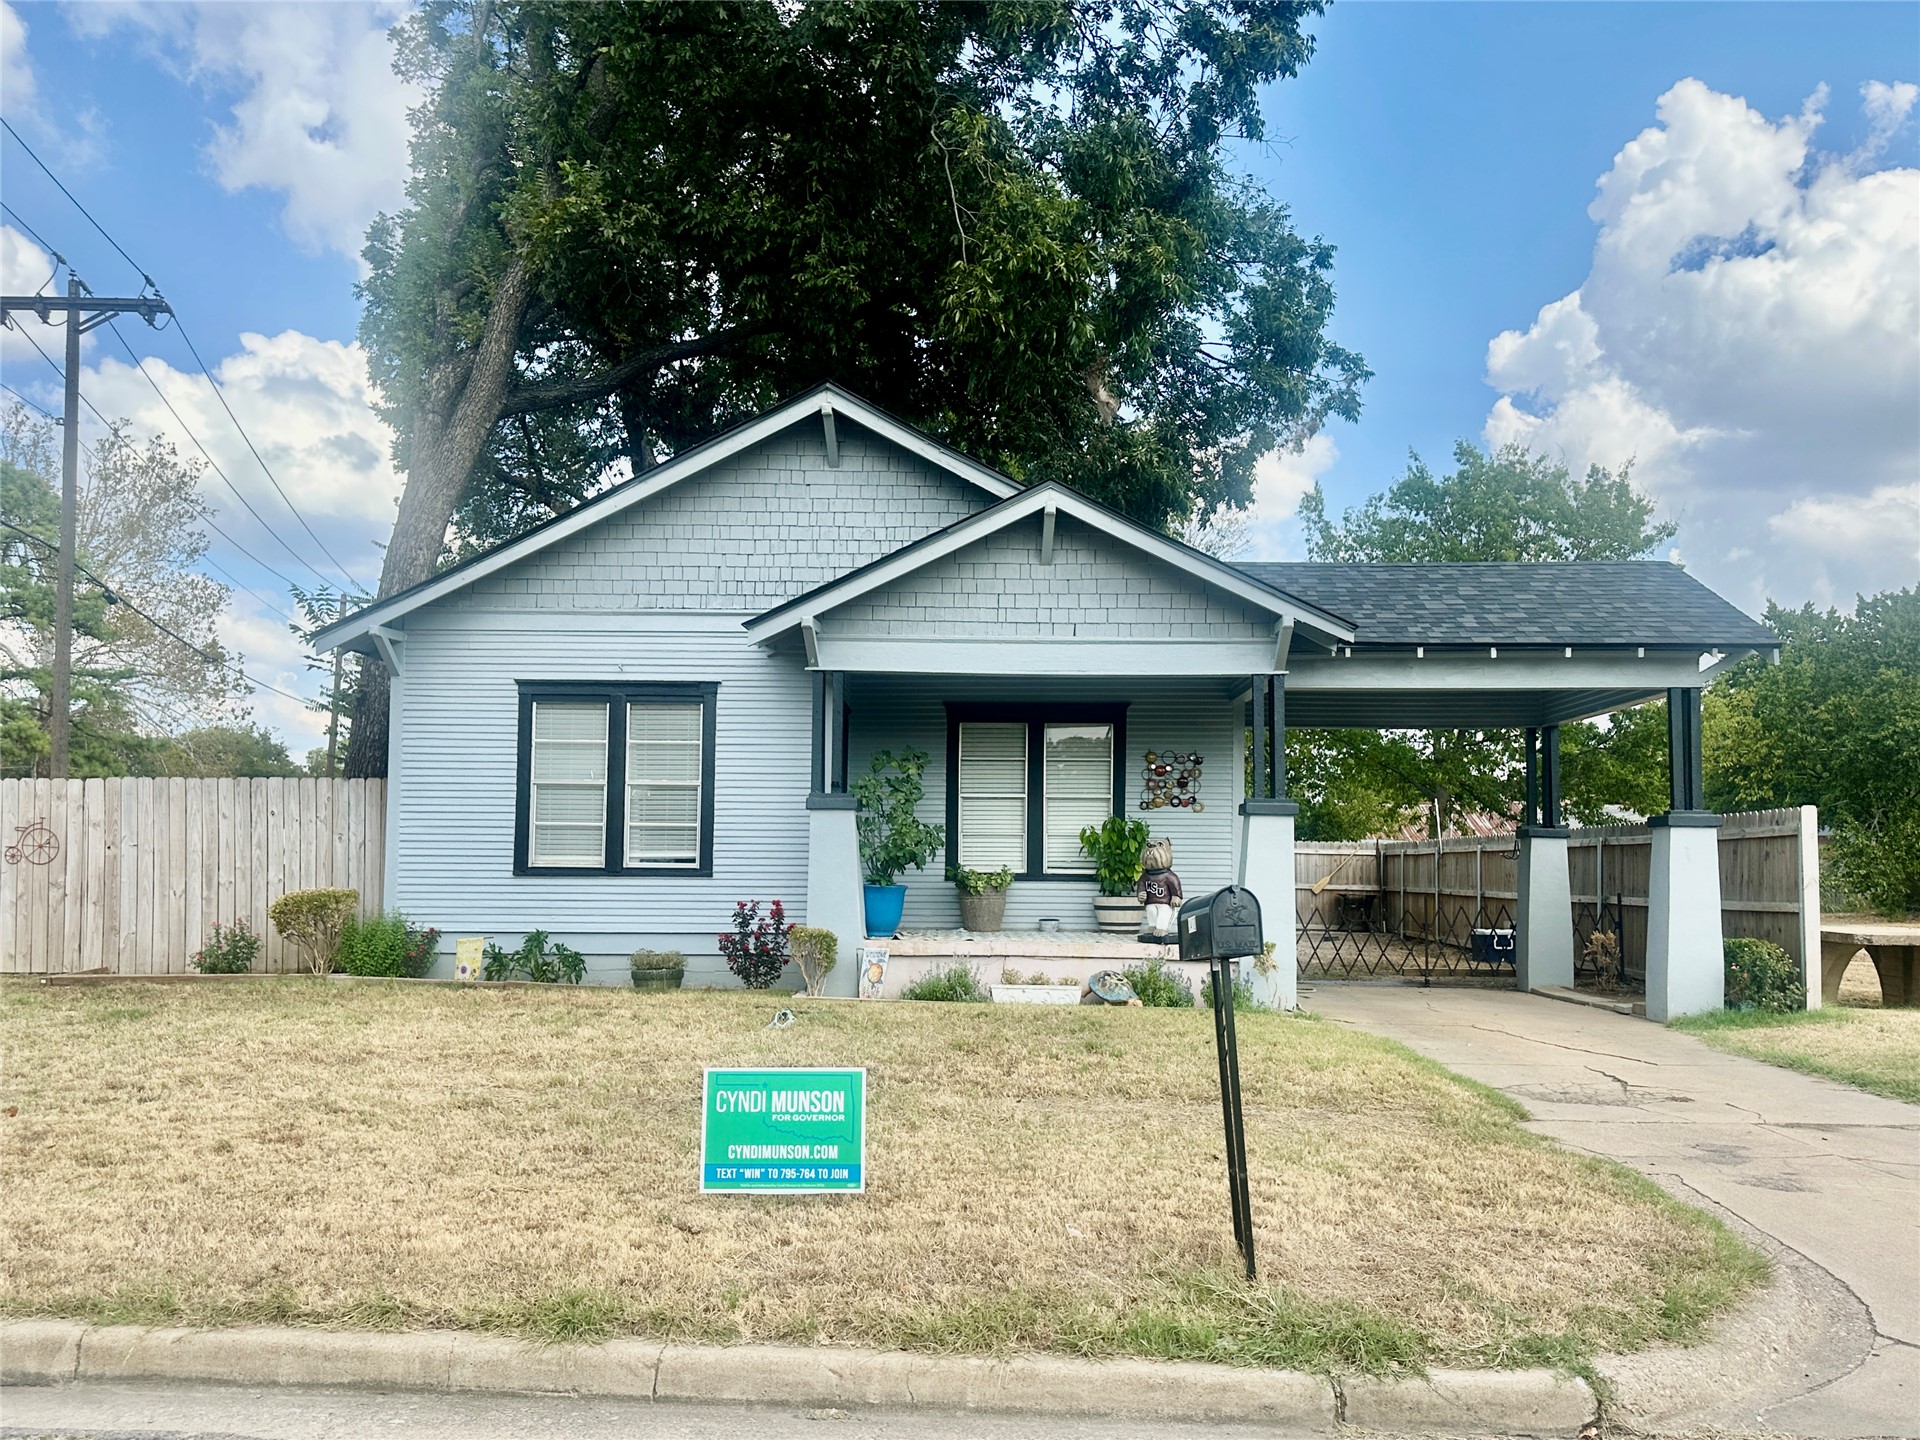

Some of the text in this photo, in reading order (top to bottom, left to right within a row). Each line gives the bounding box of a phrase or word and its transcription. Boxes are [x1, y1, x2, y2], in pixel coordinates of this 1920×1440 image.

[1146, 880, 1165, 898] MSU
[1234, 940, 1259, 948] MAIL
[716, 1090, 845, 1113] CYNDI MUNSON
[728, 1145, 838, 1159] CYNDIMUNSON.COM
[716, 1168, 849, 1179] TEXT "WIN" TO 795-764 TO JOIN
